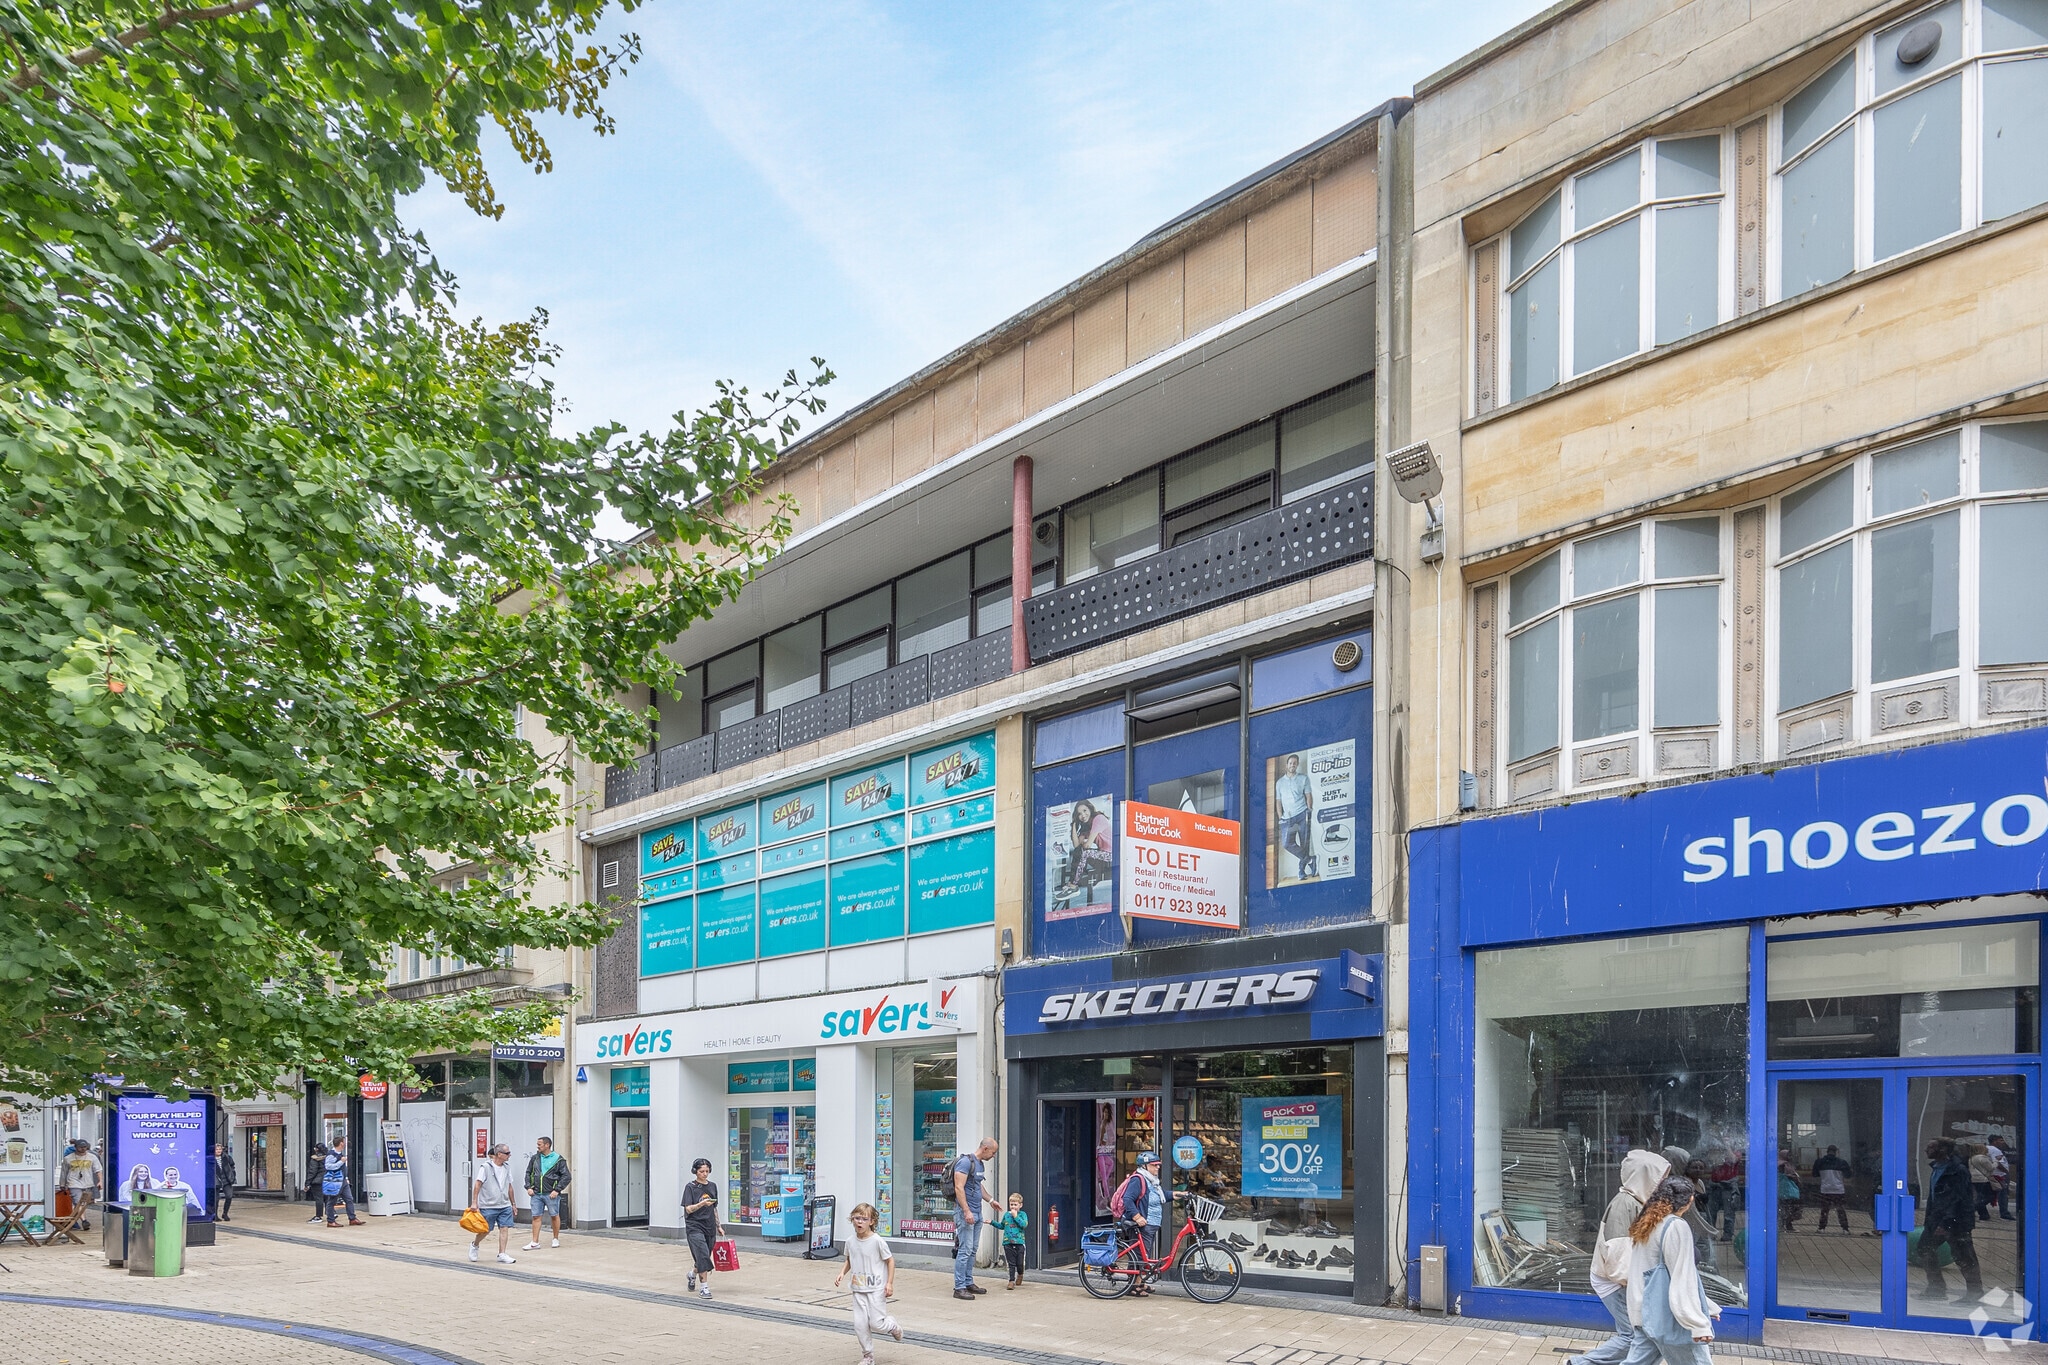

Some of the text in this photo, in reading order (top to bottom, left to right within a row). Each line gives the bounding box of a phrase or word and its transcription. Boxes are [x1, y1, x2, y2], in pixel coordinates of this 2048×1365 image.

[1311, 744, 1354, 758] SKECHERS
[928, 752, 960, 780] SAVE
[946, 759, 978, 787] 24/7
[847, 778, 875, 802] SAVE
[863, 784, 890, 810] 24/7
[774, 798, 800, 821] SAVE
[789, 805, 813, 830] 24/7
[710, 817, 733, 840] SAVE
[1135, 812, 1169, 827] Hartnell
[723, 824, 745, 846] 24/7
[1194, 822, 1232, 836] htc.uk.com
[652, 834, 674, 855] SAVE
[664, 840, 684, 861] 24/7
[1135, 846, 1200, 872] TO LET
[941, 872, 962, 882] always
[964, 869, 980, 879] open
[1135, 867, 1156, 877] Retail
[1163, 871, 1204, 884] Restaurant
[858, 888, 878, 898] always
[878, 886, 892, 895] open
[921, 878, 984, 900] savers.co.uk
[1135, 878, 1152, 888] Café
[1158, 882, 1181, 892] Office
[1188, 885, 1216, 896] Medical
[784, 903, 802, 912] always
[803, 900, 815, 910] open
[840, 895, 896, 914] savers.co.uk
[1134, 894, 1226, 918] 0117 923 9234
[719, 916, 735, 925] always
[769, 910, 818, 928] savers.co.uk
[705, 923, 749, 939] savers.co.uk
[648, 935, 688, 950] savers.co.uk
[1350, 966, 1374, 983] SKECHERS
[1038, 968, 1322, 1024] SKECHERS
[820, 994, 933, 1038] savers
[935, 1010, 958, 1021] savers
[596, 1024, 672, 1058] savers
[704, 1034, 782, 1048] HEALTH HOME BEAUTY
[1264, 1104, 1314, 1118] BACK TO
[1264, 1128, 1306, 1136] SALE!
[1260, 1143, 1323, 1174] 30%
[1303, 1166, 1322, 1174] OFF
[766, 1200, 779, 1208] SAVE
